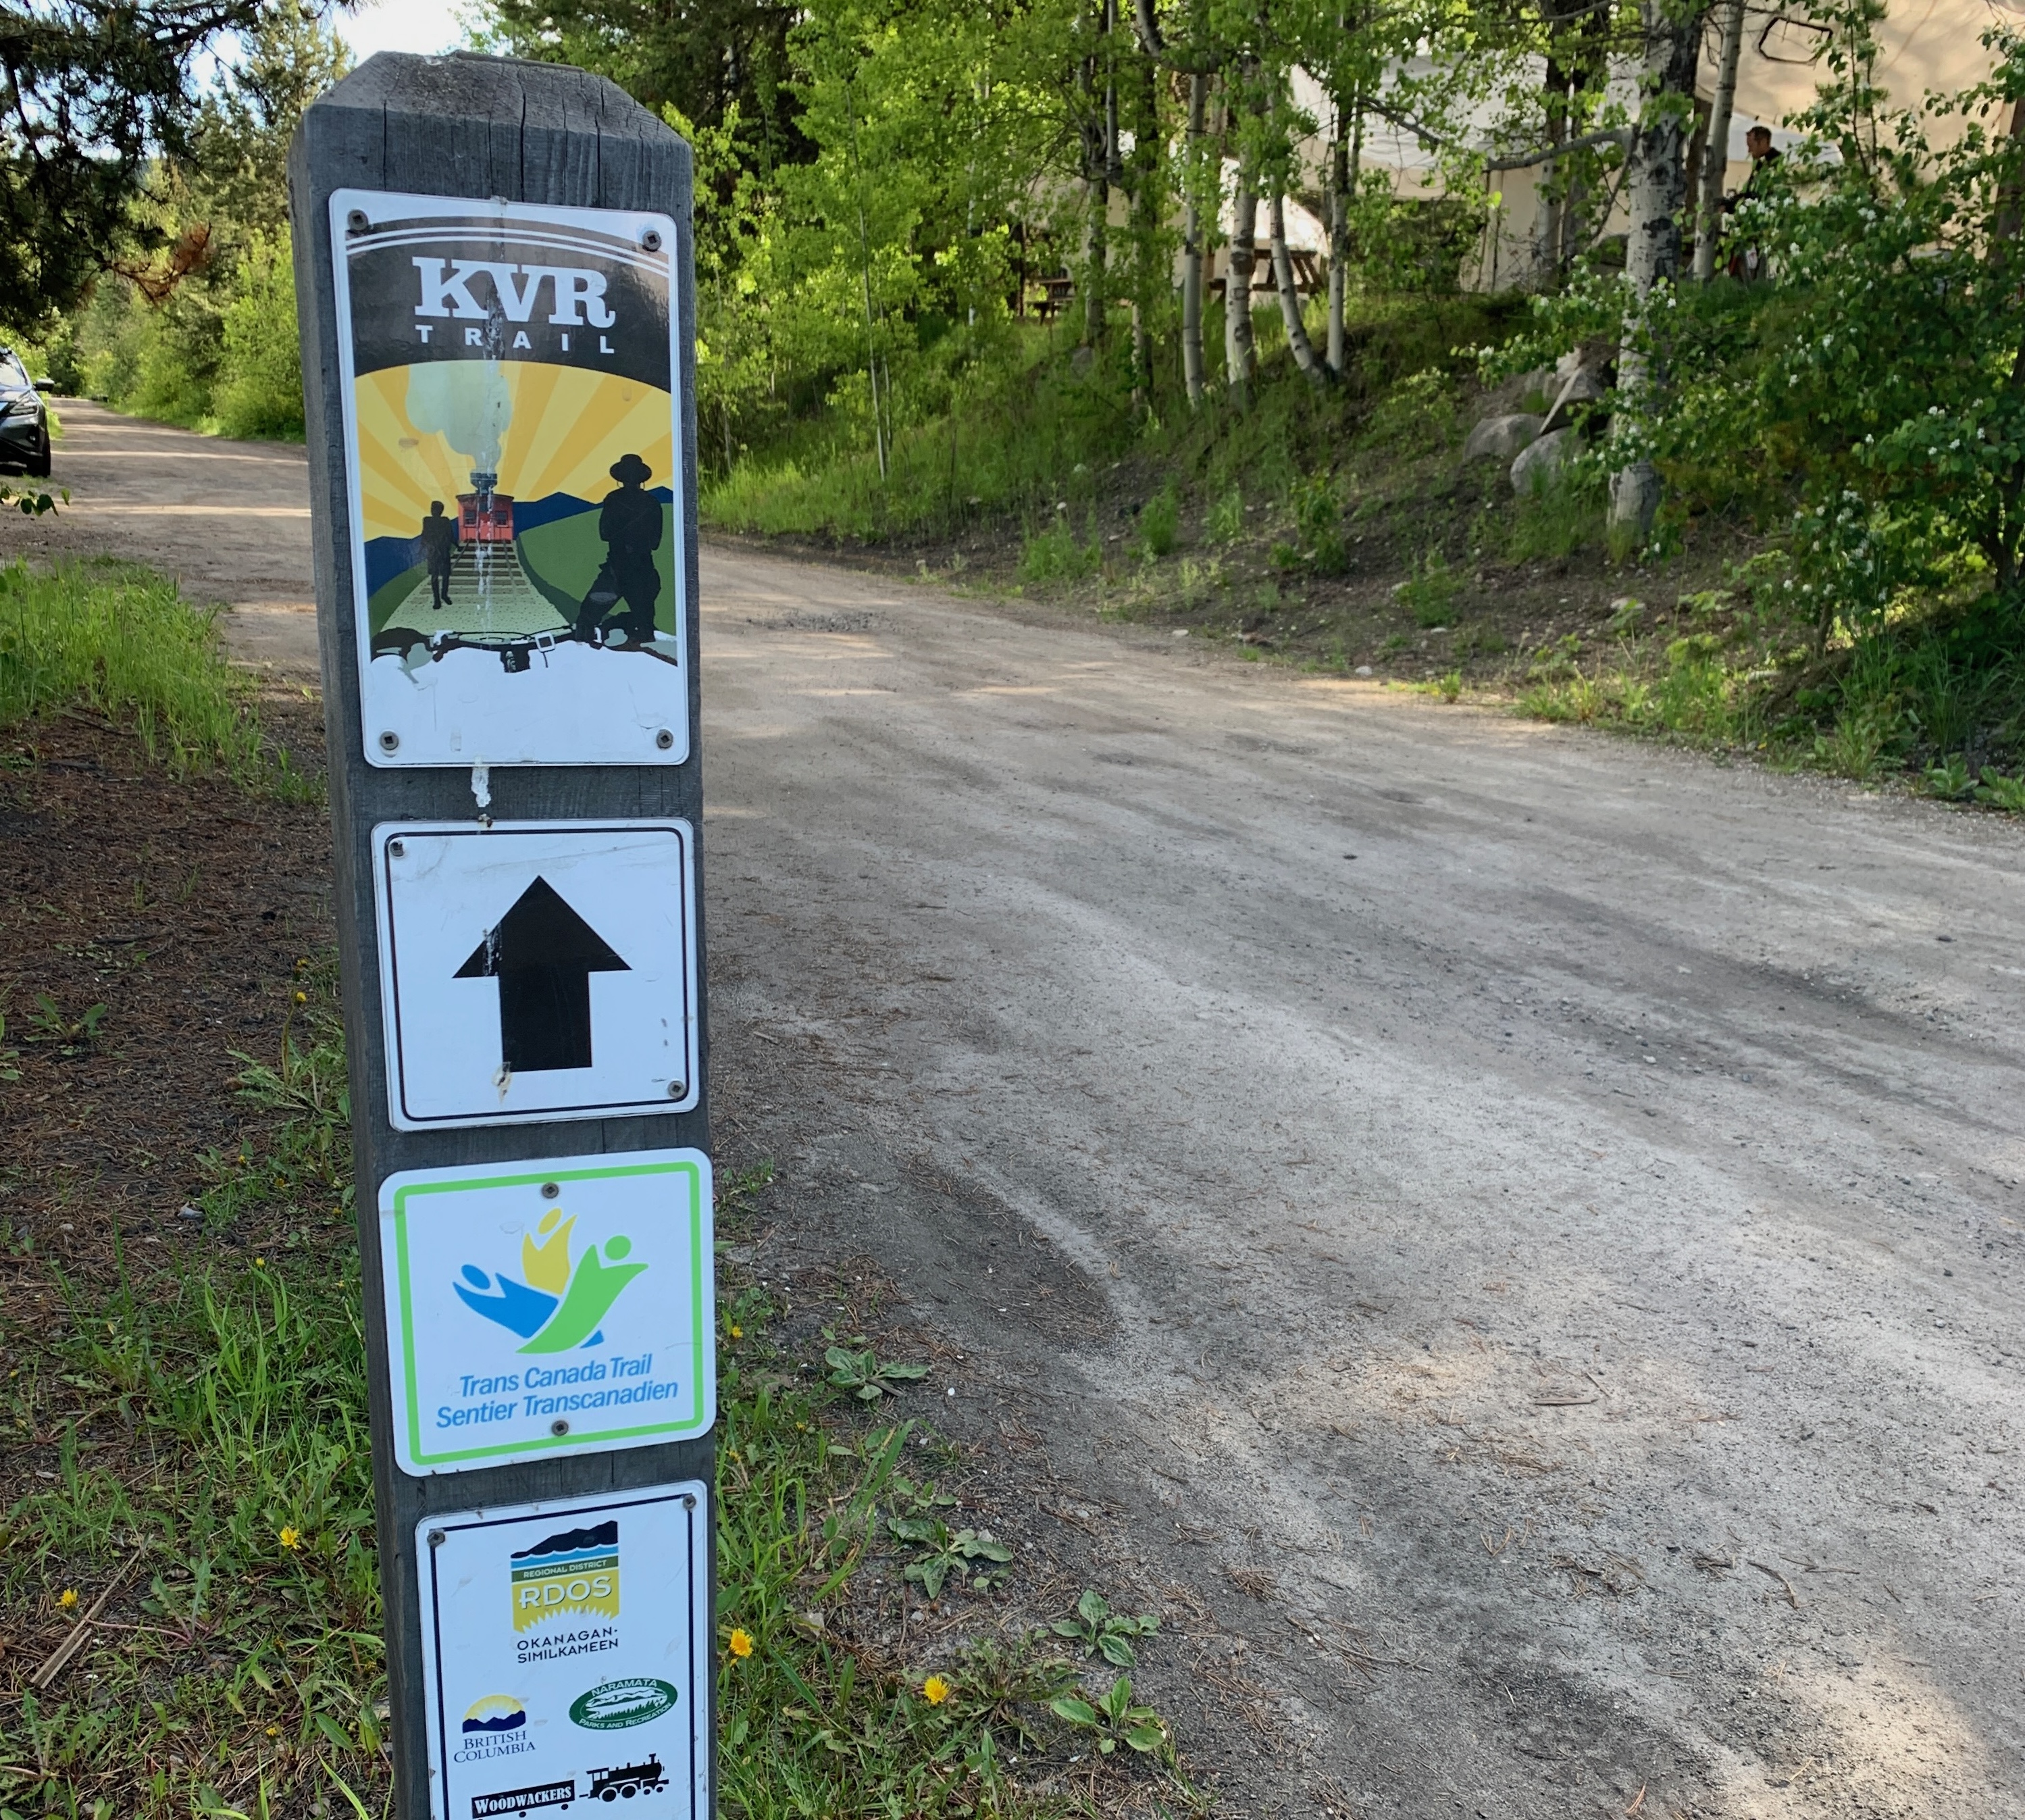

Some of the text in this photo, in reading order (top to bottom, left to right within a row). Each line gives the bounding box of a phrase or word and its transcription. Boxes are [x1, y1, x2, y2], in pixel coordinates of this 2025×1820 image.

[412, 257, 615, 329] KVR
[415, 324, 614, 354] TRAIL
[459, 1354, 652, 1397] Trans Canada Trail
[436, 1380, 679, 1428] Sentier Transcanadien
[523, 1559, 607, 1578] REGIONAL DISTRICT
[518, 1576, 612, 1609] RDOS
[517, 1638, 618, 1663] SIMILKAMEEN
[591, 1679, 657, 1697] NARAMATA
[579, 1718, 605, 1729] PARKS
[625, 1702, 672, 1727] RECREATION
[454, 1742, 536, 1763] COLUMBIA
[463, 1730, 526, 1750] BRITISH
